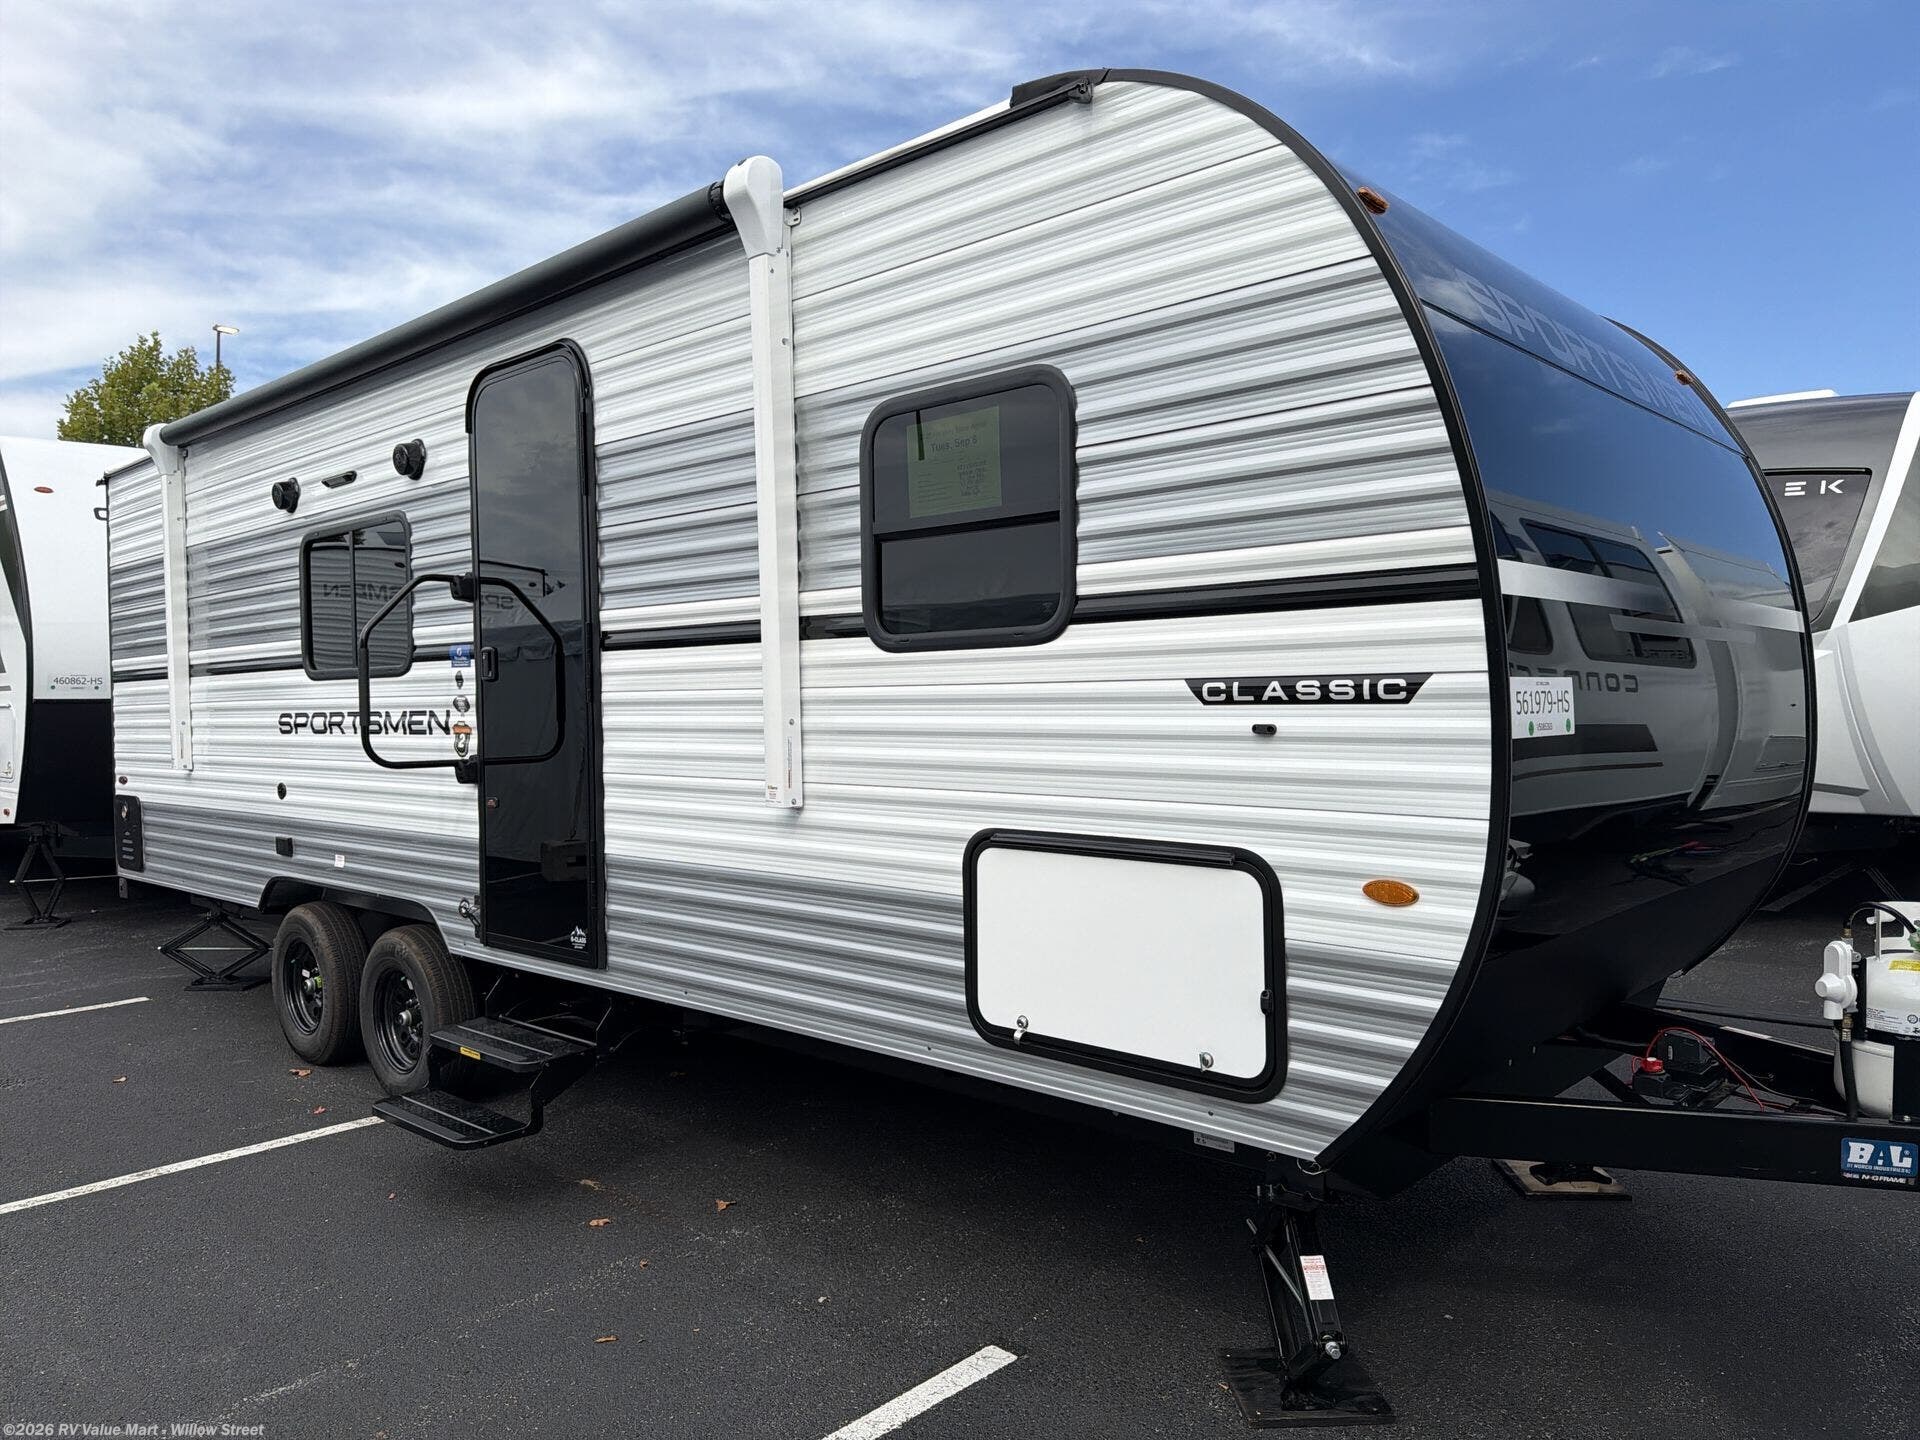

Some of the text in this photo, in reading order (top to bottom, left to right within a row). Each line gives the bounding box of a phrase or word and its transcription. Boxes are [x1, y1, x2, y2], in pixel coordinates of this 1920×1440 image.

[53, 676, 103, 685] 460862-HS
[1201, 678, 1408, 702] CLASSIC
[1515, 690, 1571, 715] 561979-HS
[278, 710, 451, 735] SPORTSMEN
[1848, 1142, 1912, 1168] BAL
